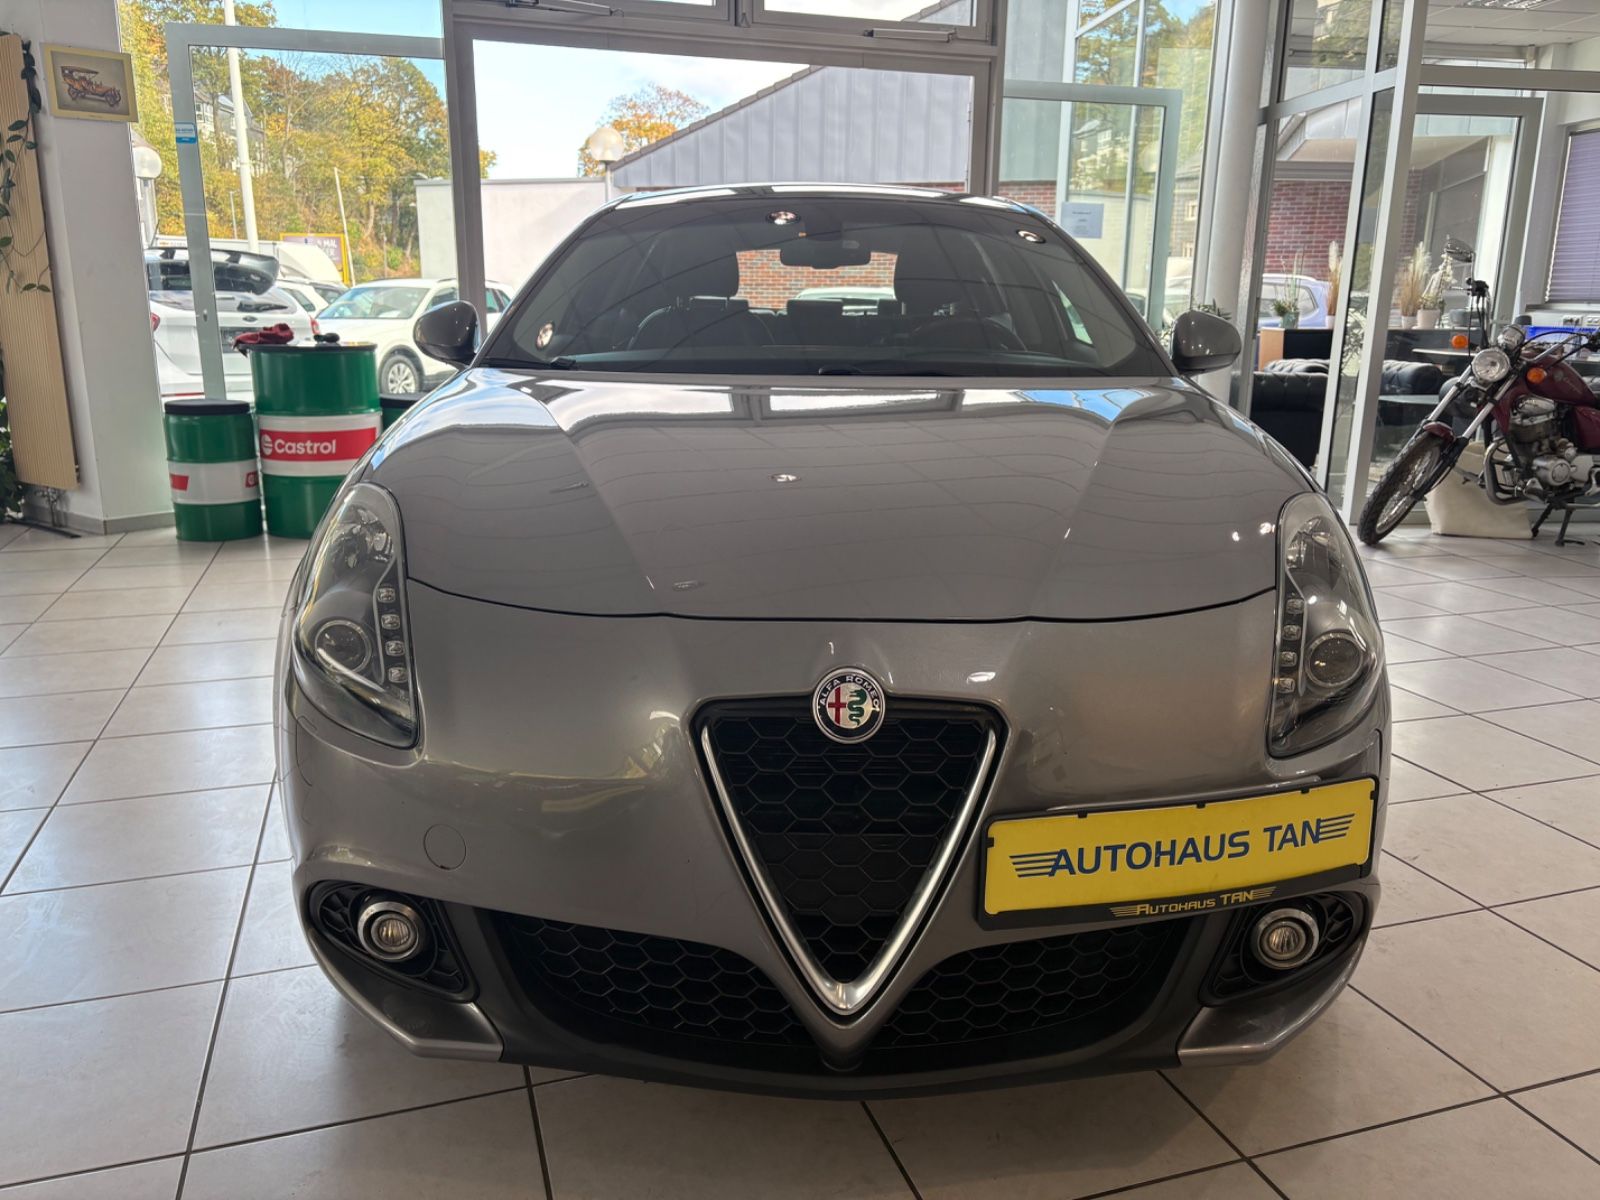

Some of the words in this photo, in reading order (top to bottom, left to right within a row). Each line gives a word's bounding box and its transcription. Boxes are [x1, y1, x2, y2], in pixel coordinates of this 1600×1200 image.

[274, 438, 336, 455] Castrol
[820, 678, 841, 706] ALFA
[846, 675, 880, 708] ROMEO
[1048, 831, 1250, 877] AUTOHAUS
[1263, 818, 1323, 852] TAN
[1220, 890, 1255, 905] TAN
